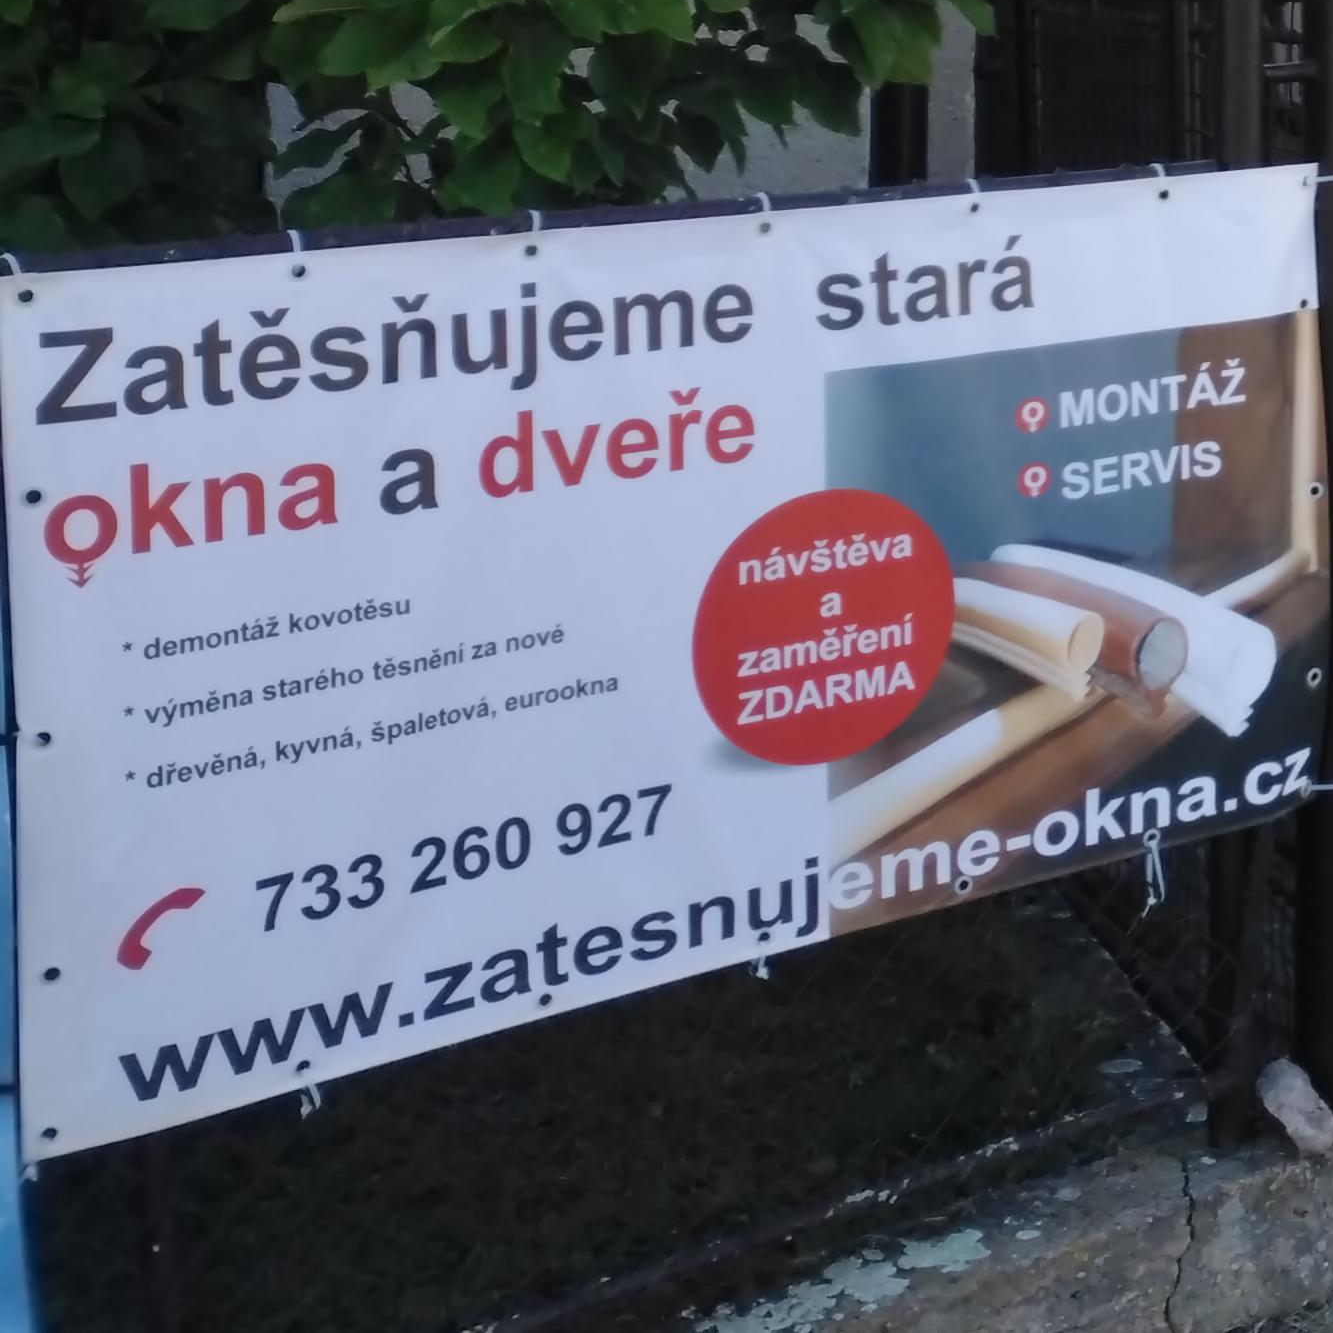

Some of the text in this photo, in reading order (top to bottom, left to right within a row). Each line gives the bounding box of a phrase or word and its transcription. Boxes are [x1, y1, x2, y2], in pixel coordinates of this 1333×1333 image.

[36, 234, 1034, 426] Zatěsňujeme stará
[1059, 357, 1247, 428] MONTÁŽ
[43, 387, 755, 574] okna a dveře
[1062, 441, 1223, 500] SERVIS
[738, 529, 913, 585] návštěva
[143, 596, 411, 660] demontáž kovotěsu
[819, 589, 843, 617] a
[145, 623, 565, 727] výměna starého těsnění za nové
[737, 615, 913, 677] zaměření
[737, 660, 915, 725] ZDARMA
[146, 674, 619, 789] dřevěná, kyvná, špaletová, eurookna
[255, 783, 673, 933] 733 260 927
[118, 745, 1313, 1101] www.zatesnujeme-okna.cz
